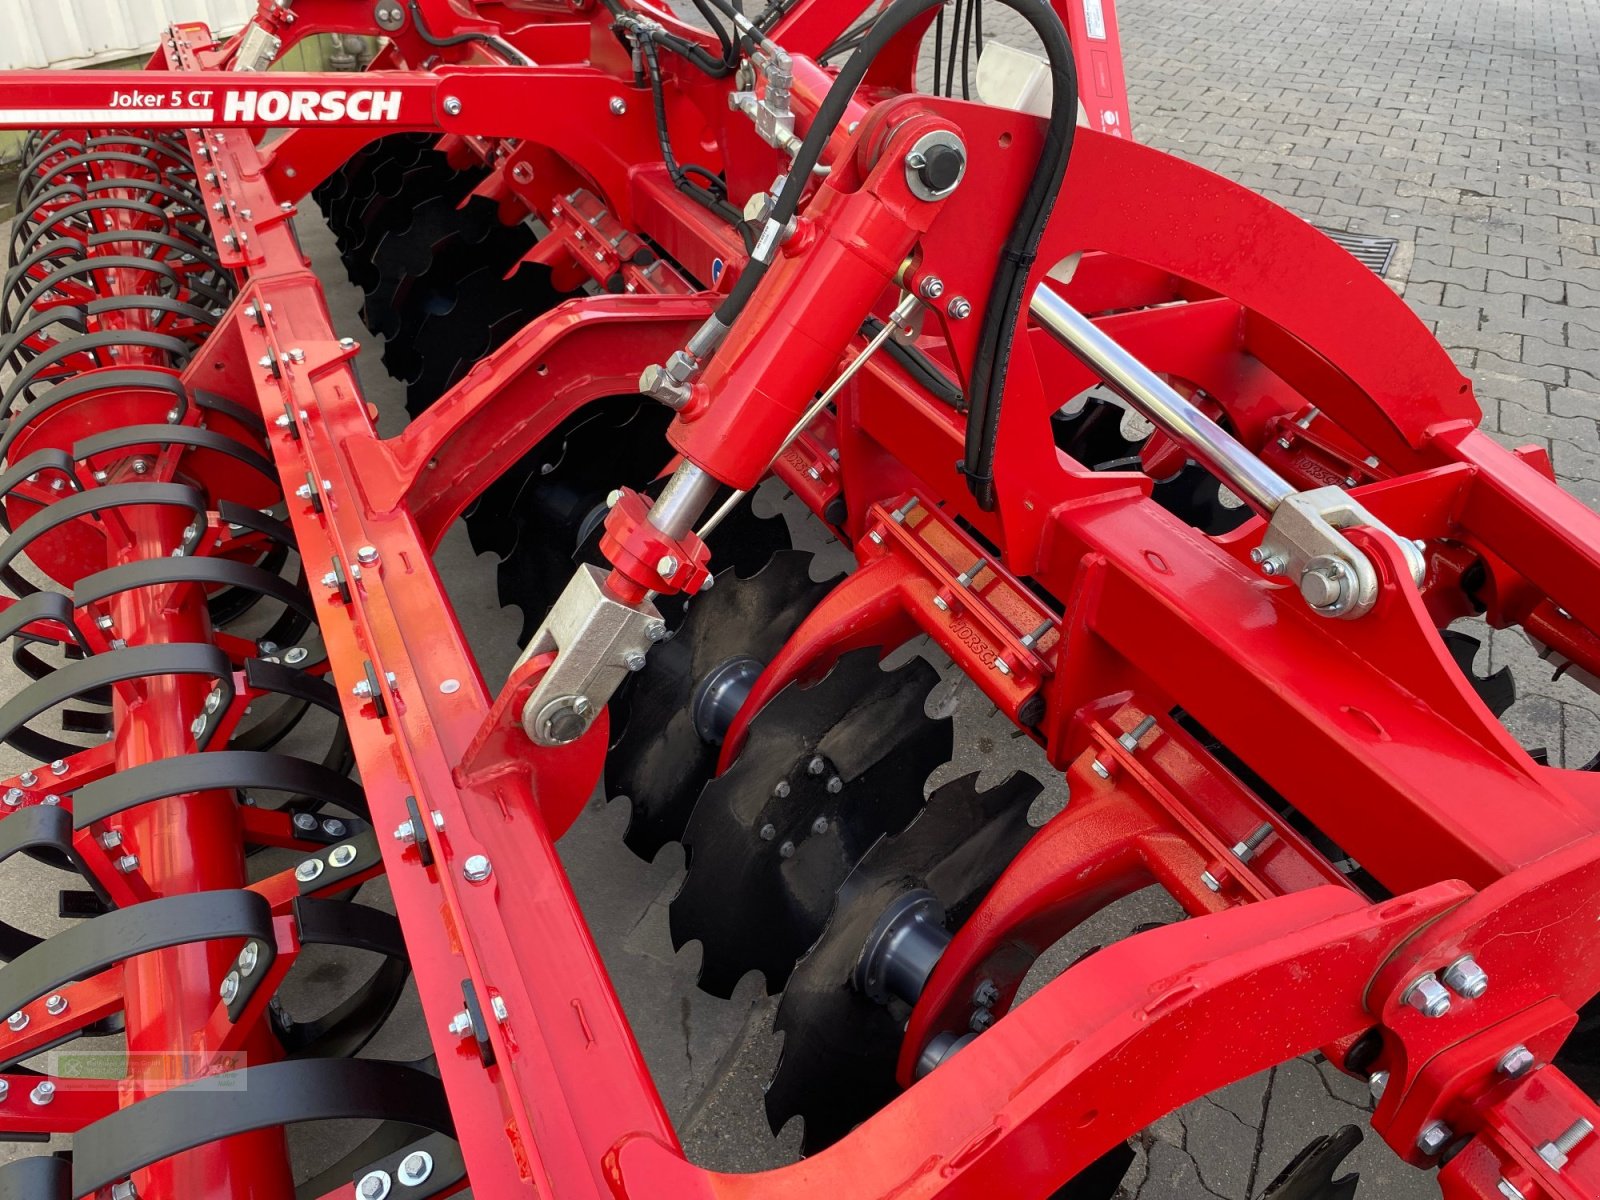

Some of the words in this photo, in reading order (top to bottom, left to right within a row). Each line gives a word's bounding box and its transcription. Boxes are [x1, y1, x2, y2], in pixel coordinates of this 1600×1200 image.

[109, 90, 166, 107] Joker
[170, 90, 183, 107] 5
[187, 90, 214, 107] CT
[223, 90, 403, 122] HORSCH
